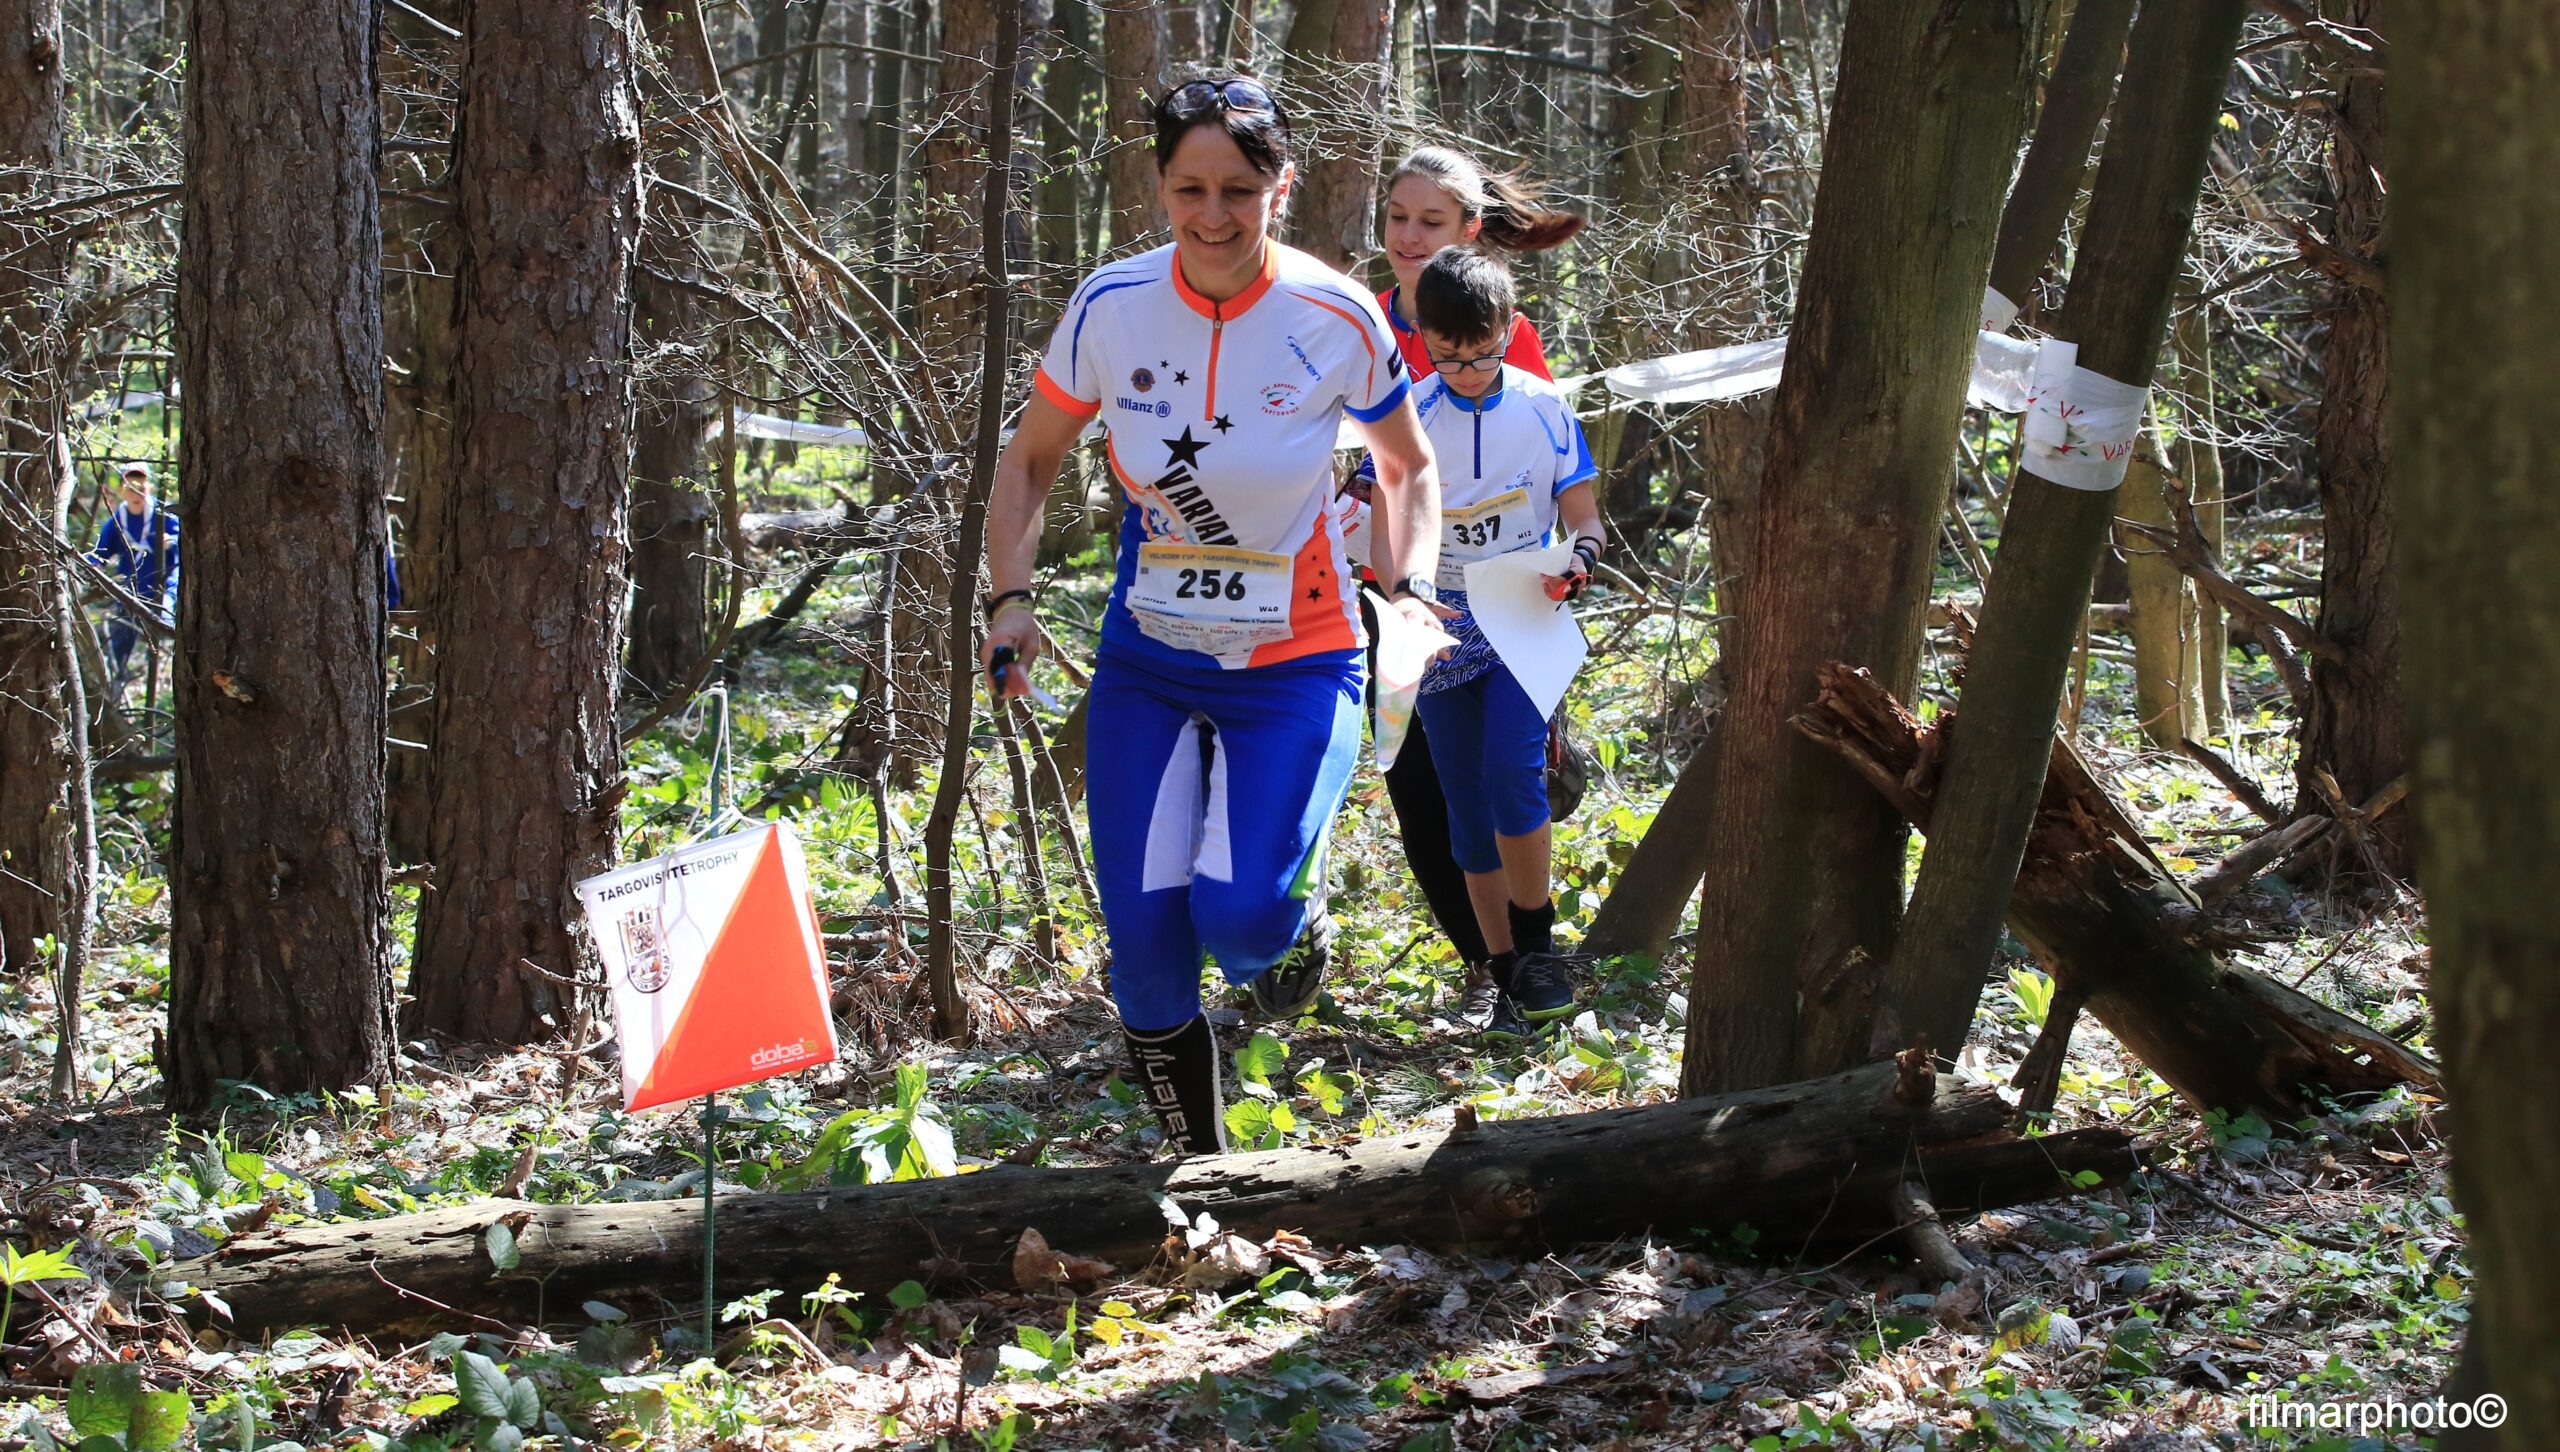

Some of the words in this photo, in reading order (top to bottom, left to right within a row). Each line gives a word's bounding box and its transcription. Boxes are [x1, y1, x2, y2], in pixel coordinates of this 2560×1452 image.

[1452, 514, 1501, 547] 337
[1517, 530, 1532, 540] M12
[1176, 568, 1246, 601] 256
[1259, 605, 1279, 613] W40
